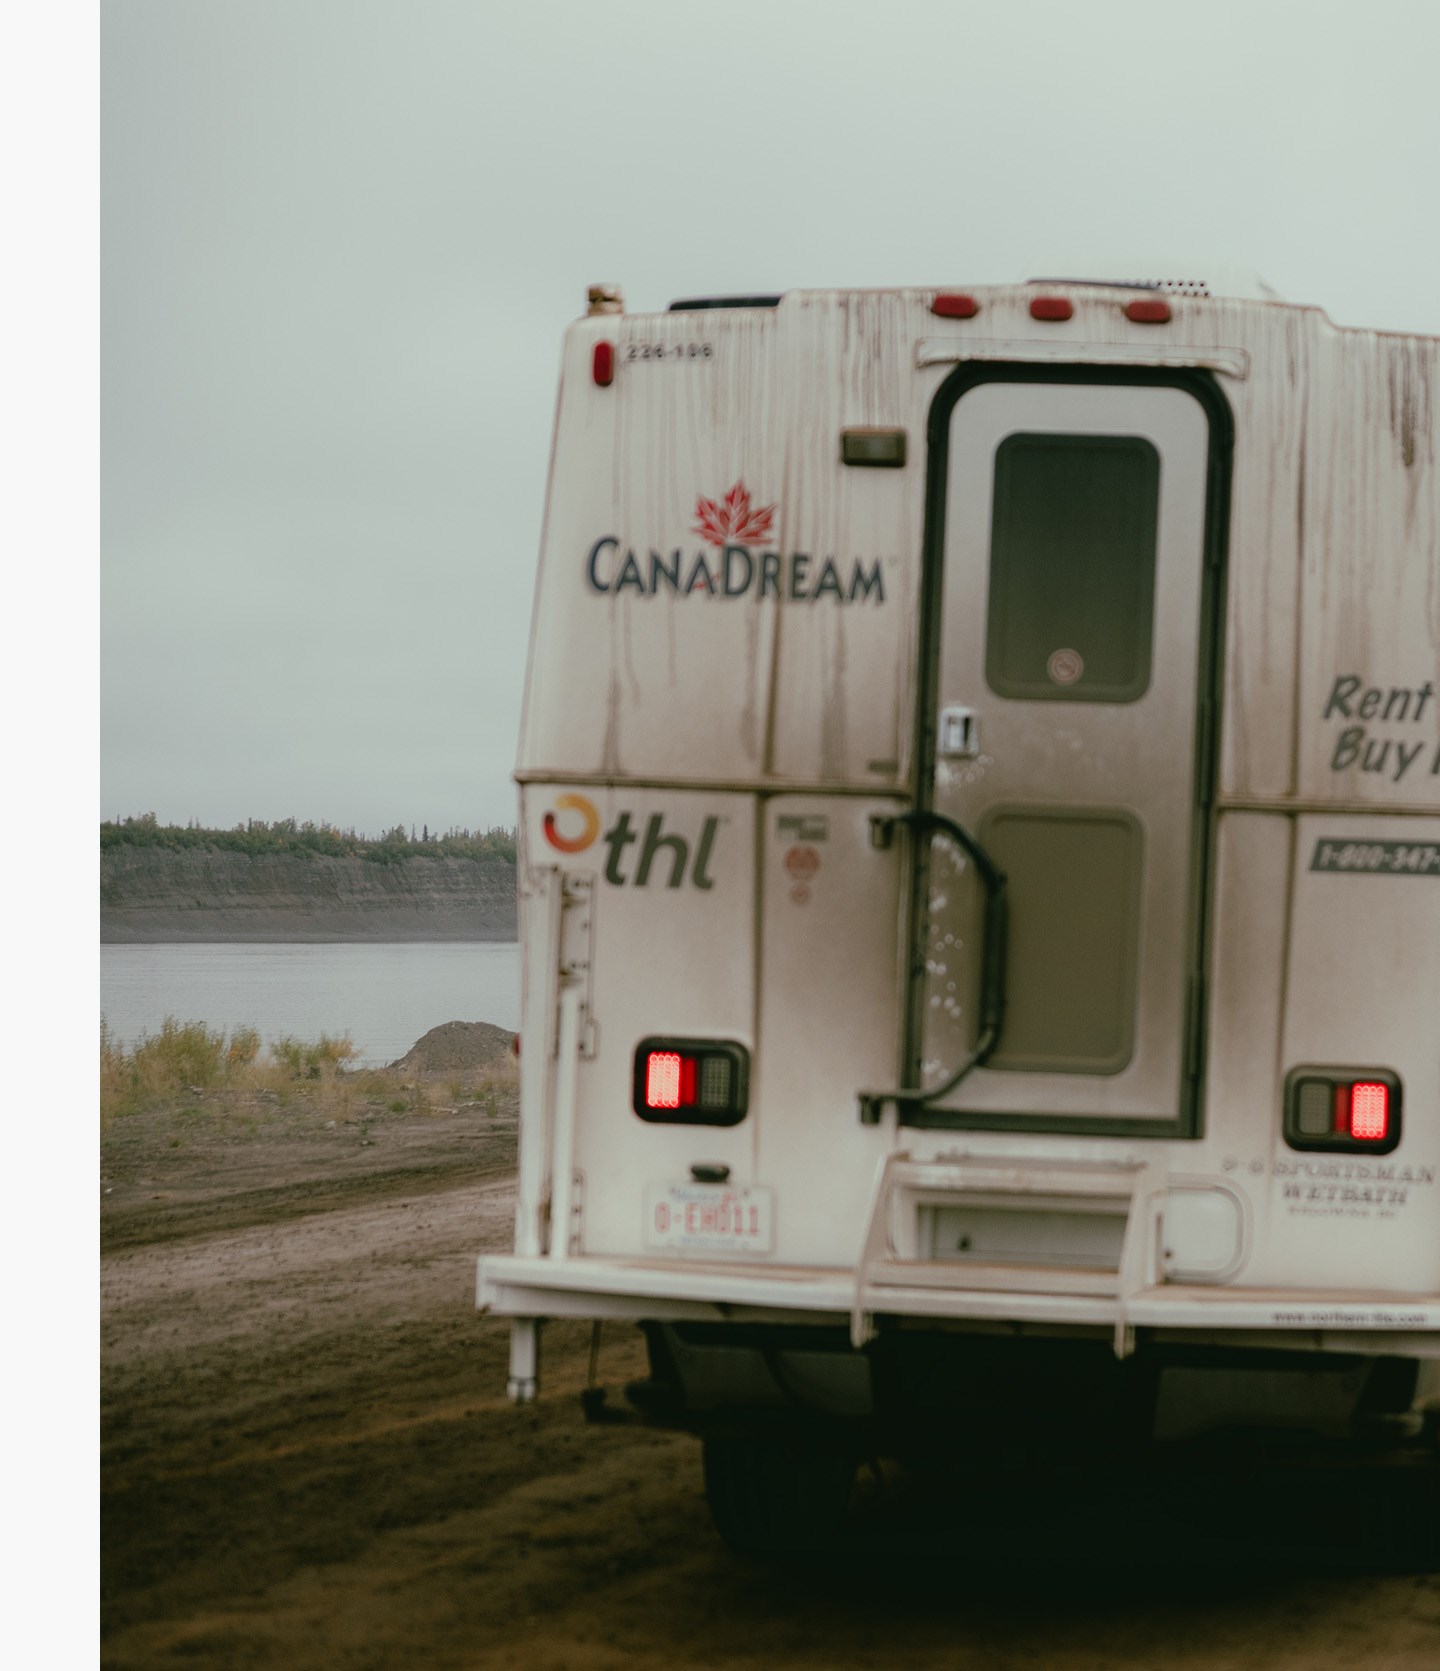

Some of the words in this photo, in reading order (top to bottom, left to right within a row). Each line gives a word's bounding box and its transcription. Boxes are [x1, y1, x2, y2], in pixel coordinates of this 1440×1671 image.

[1323, 674, 1435, 721] Rent
[1330, 725, 1425, 782] Buy
[603, 811, 719, 890] thl
